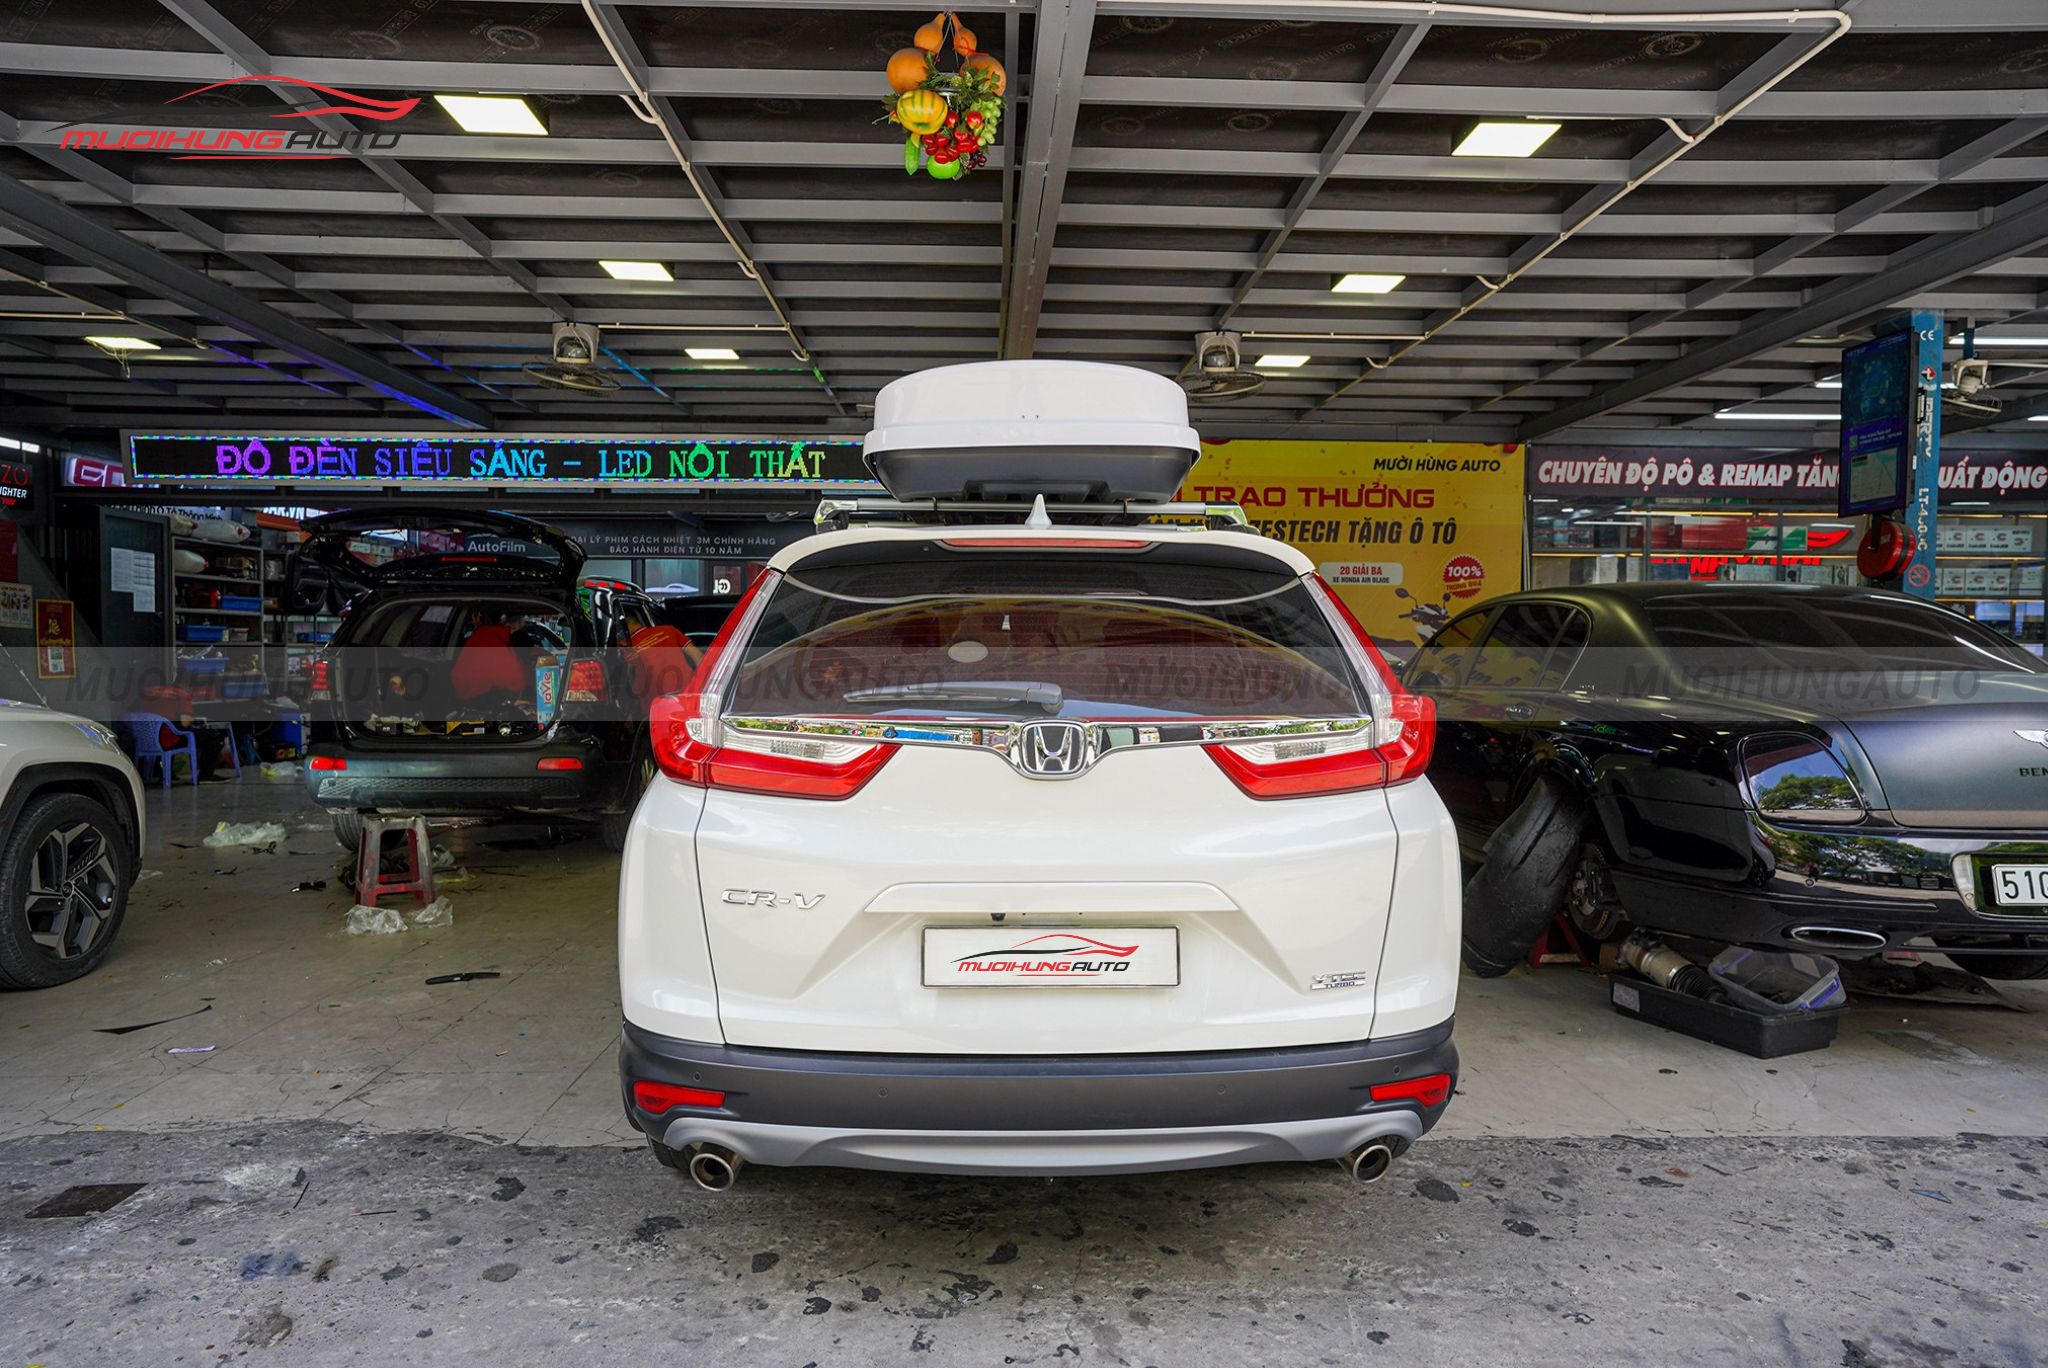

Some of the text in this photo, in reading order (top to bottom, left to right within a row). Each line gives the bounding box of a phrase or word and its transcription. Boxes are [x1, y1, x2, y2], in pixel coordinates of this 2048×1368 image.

[375, 440, 451, 476] SIÊU
[599, 450, 652, 478] LED
[1415, 457, 1458, 472] HÙNG
[1460, 459, 1501, 472] AUTO
[1537, 455, 2048, 496] CHUYÊN ĐỘ PÔ & REMAP TĂN UẤT ĐỘNG
[1193, 486, 1287, 507] TRAO
[605, 536, 629, 544] PHIM
[1348, 517, 1406, 548] TẶNG
[467, 539, 527, 553] AutoFilm
[1340, 566, 1350, 575] 20
[1371, 566, 1383, 576] BA
[1447, 565, 1482, 577] 100%
[721, 887, 826, 910] CR-V
[1324, 981, 1355, 989] TURBO
